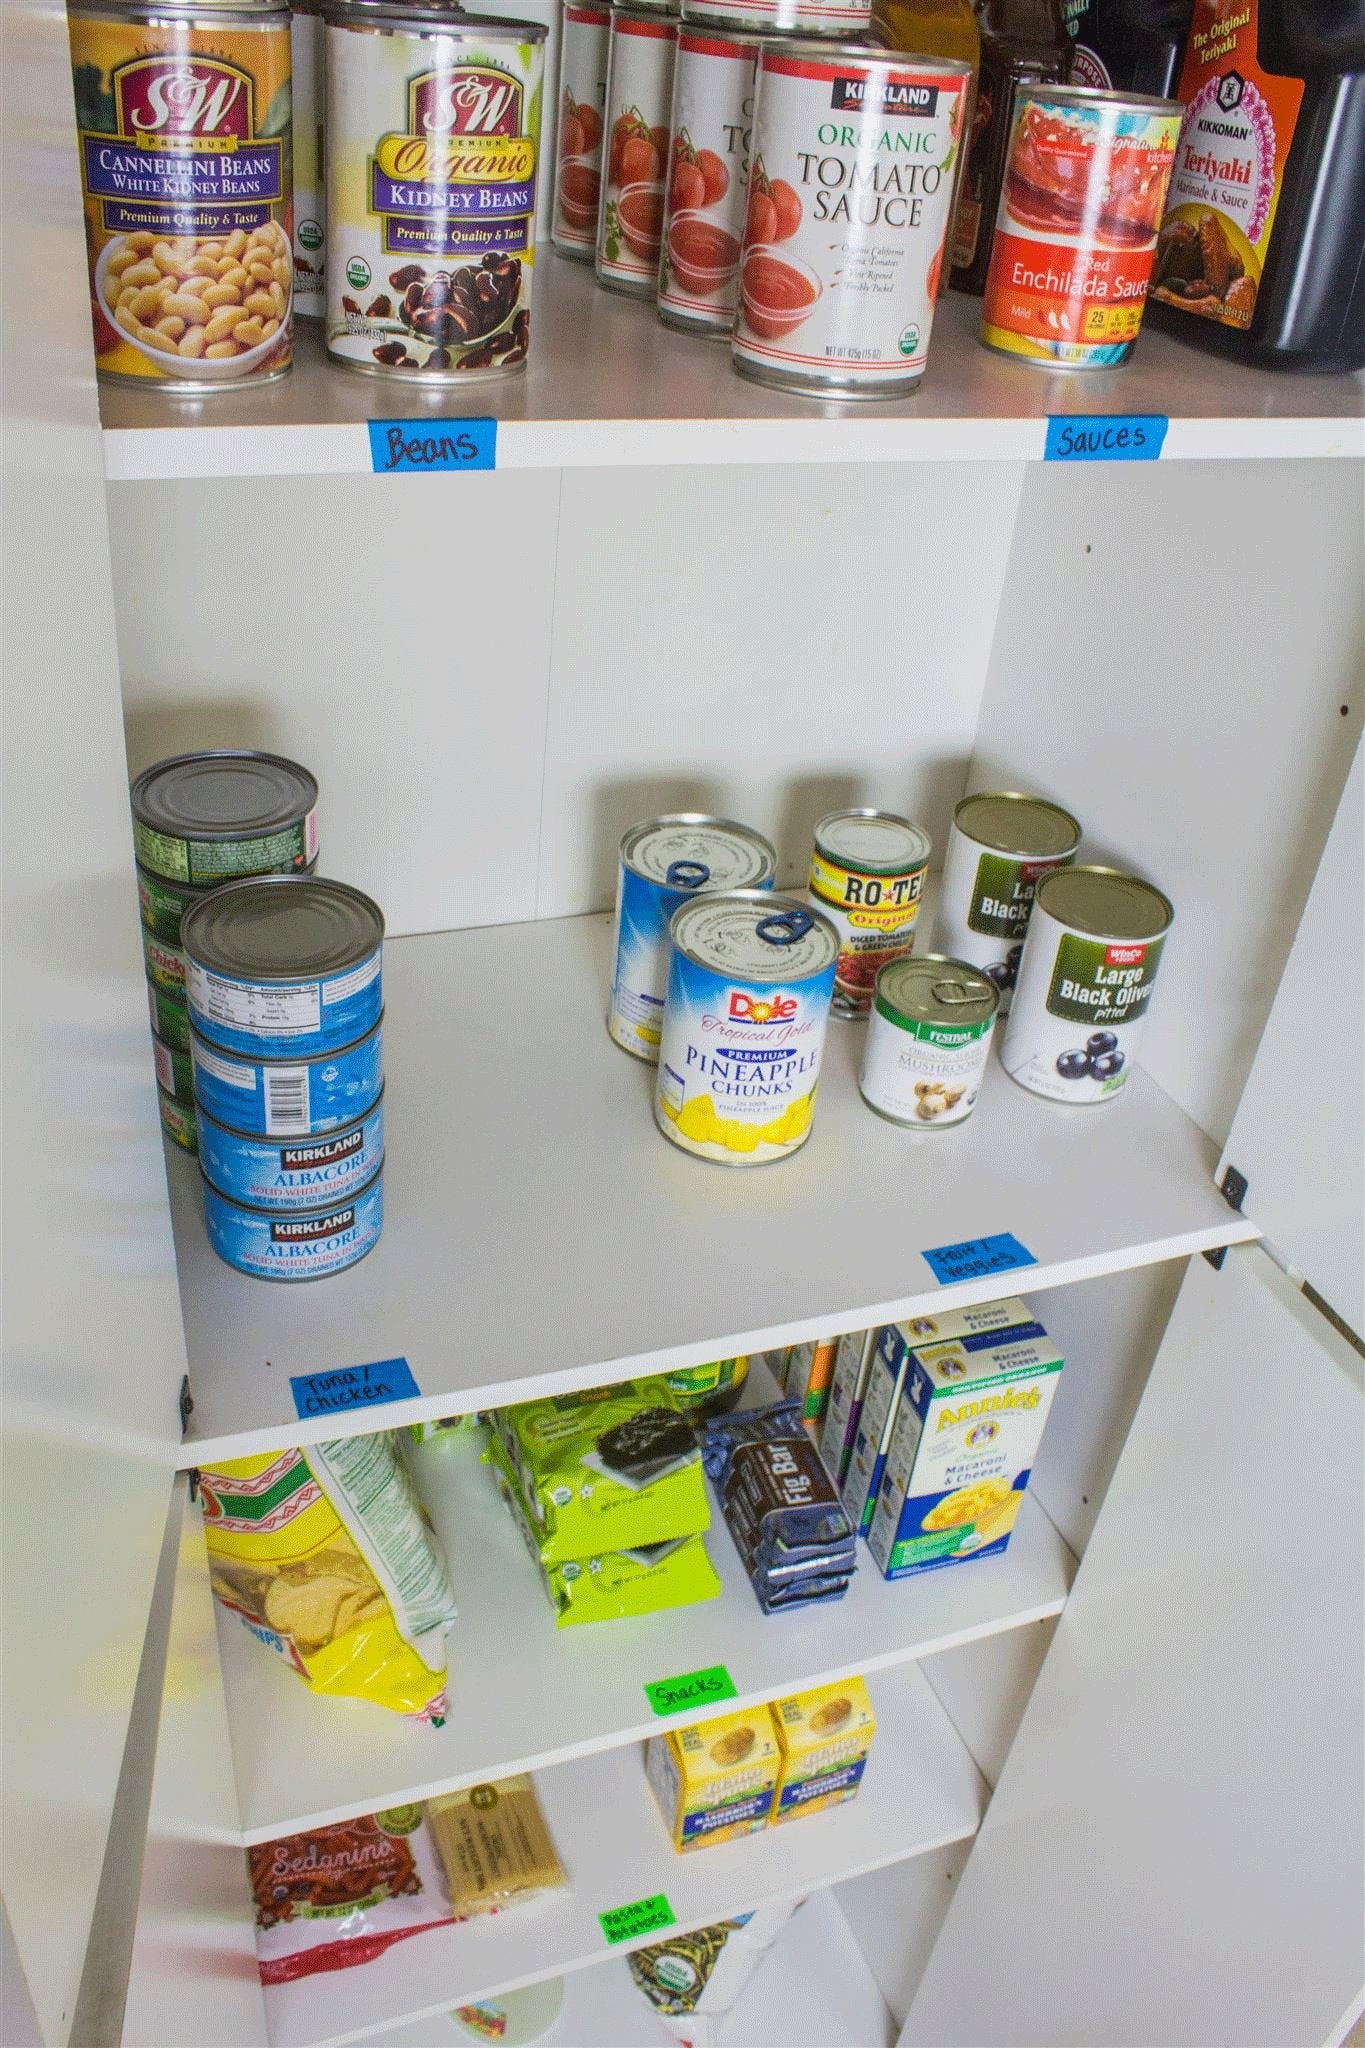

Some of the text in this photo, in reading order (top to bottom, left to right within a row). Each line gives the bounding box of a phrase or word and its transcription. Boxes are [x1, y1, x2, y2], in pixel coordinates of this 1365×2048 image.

[1194, 8, 1250, 49] The Original
[1201, 35, 1237, 64] Teriyaki
[845, 82, 930, 105] KIKLAND
[817, 123, 937, 154] ORANIC
[1198, 119, 1248, 140] KIKKOMAN
[220, 156, 272, 177] BEANS
[797, 152, 942, 196] TOMATO
[1184, 144, 1252, 185] Teriyaki
[112, 173, 260, 195] WHITE KIDNEY BEANS
[391, 184, 528, 209] KIDNEY BEANS
[1211, 190, 1218, 201] &
[1221, 192, 1248, 209] Sauce
[120, 208, 259, 228] Premium Quality & Taste
[813, 190, 924, 228] SAUCE
[397, 227, 524, 243] Premium Quality & Taste
[1012, 261, 1109, 298] Enchilada
[1092, 310, 1104, 324] 25
[385, 427, 479, 470] Beans
[1057, 426, 1146, 456] Sauces
[981, 896, 1028, 920] Black
[854, 912, 914, 927] Origina
[1094, 966, 1144, 987] Large
[1060, 979, 1111, 1006] Black
[729, 991, 798, 1022] Dole
[1094, 1004, 1129, 1021] pitted
[686, 1044, 818, 1083] PINEAPPLE
[728, 1050, 788, 1063] PREMIUM
[711, 1079, 793, 1098] CHUNKS
[285, 1131, 361, 1163] KIRKLAND
[274, 1152, 366, 1187] ALBACORE
[285, 1186, 320, 1197] WHITE
[323, 1177, 349, 1192] TUNA
[275, 1209, 352, 1236] KIRKLAND
[264, 1226, 361, 1258] ALBACORE
[275, 1257, 311, 1267] WHITE
[313, 1250, 340, 1264] TUNA
[962, 1307, 1007, 1321] Macaroni
[978, 1316, 1009, 1328] Cheese
[992, 1347, 1036, 1361] Macaroni
[1007, 1356, 1039, 1368] Cheese
[767, 1443, 813, 1504] Fig Bar
[945, 1454, 1007, 1475] Macaroni
[943, 1466, 1002, 1486] & Cheese
